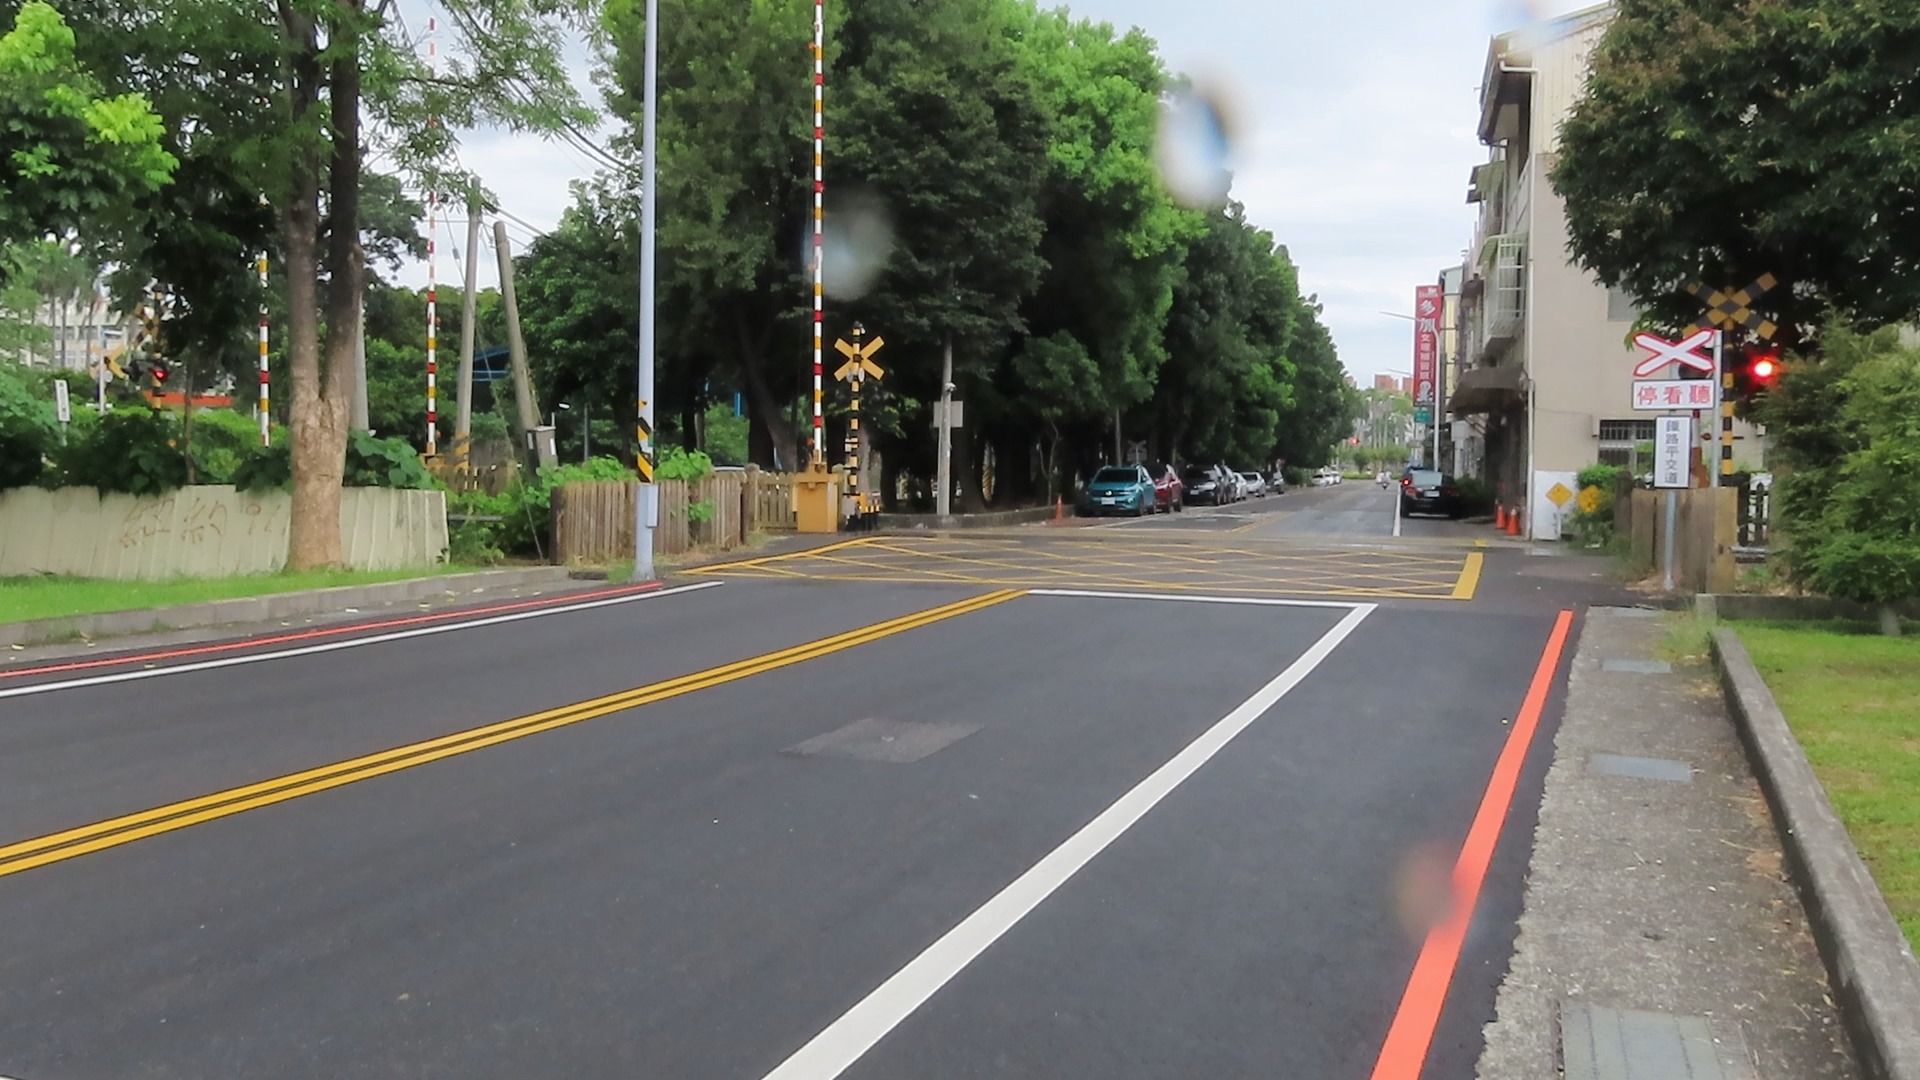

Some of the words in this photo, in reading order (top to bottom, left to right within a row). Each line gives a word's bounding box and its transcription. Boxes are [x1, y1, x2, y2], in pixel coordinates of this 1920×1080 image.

[1637, 384, 1712, 406] 停看聽
[1664, 419, 1680, 485] 鐵路平交道
